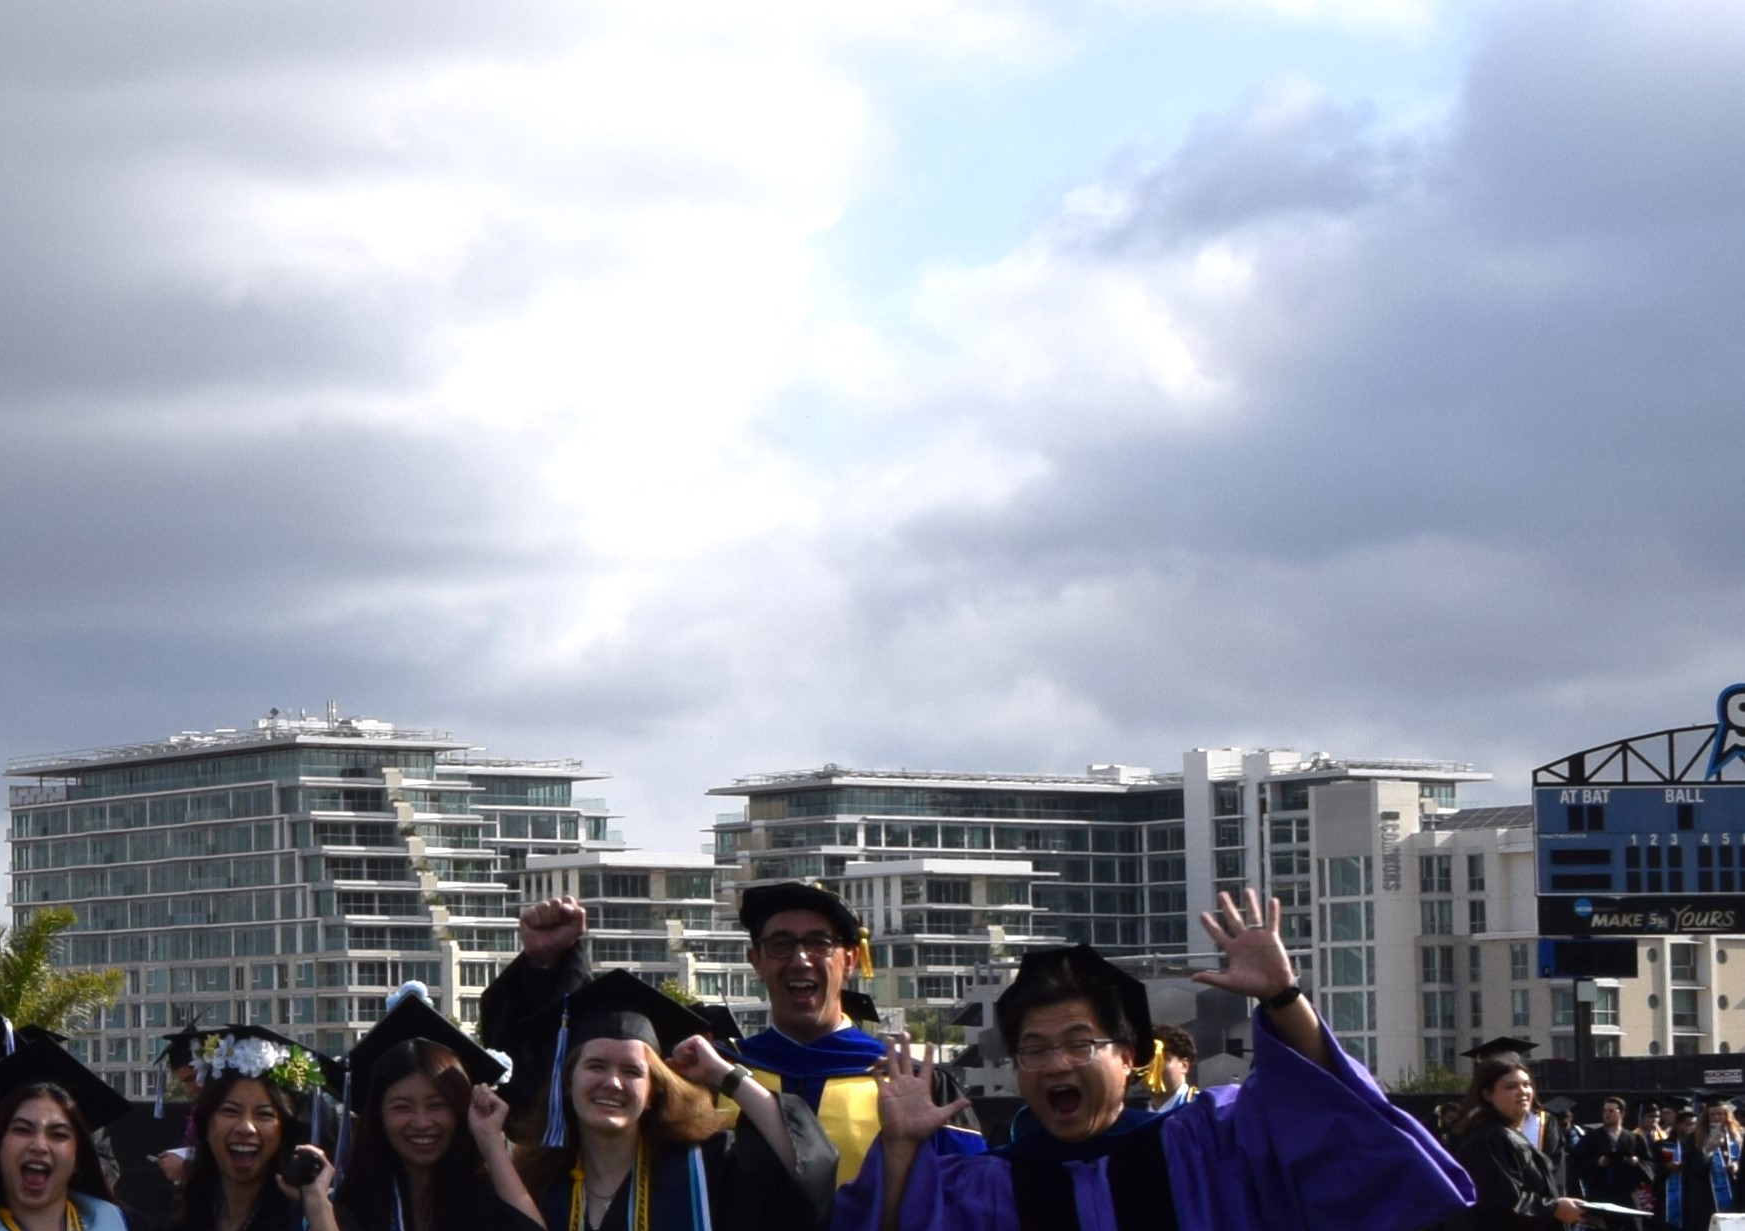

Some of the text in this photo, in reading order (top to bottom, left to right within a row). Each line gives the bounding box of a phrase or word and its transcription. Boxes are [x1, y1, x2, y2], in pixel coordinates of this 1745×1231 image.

[1560, 789, 1610, 804] AT BAT
[1665, 788, 1704, 803] BALL
[1630, 833, 1730, 845] 1 2 3 4 5
[1590, 913, 1644, 928] MAKE
[1670, 904, 1735, 933] YOURS
